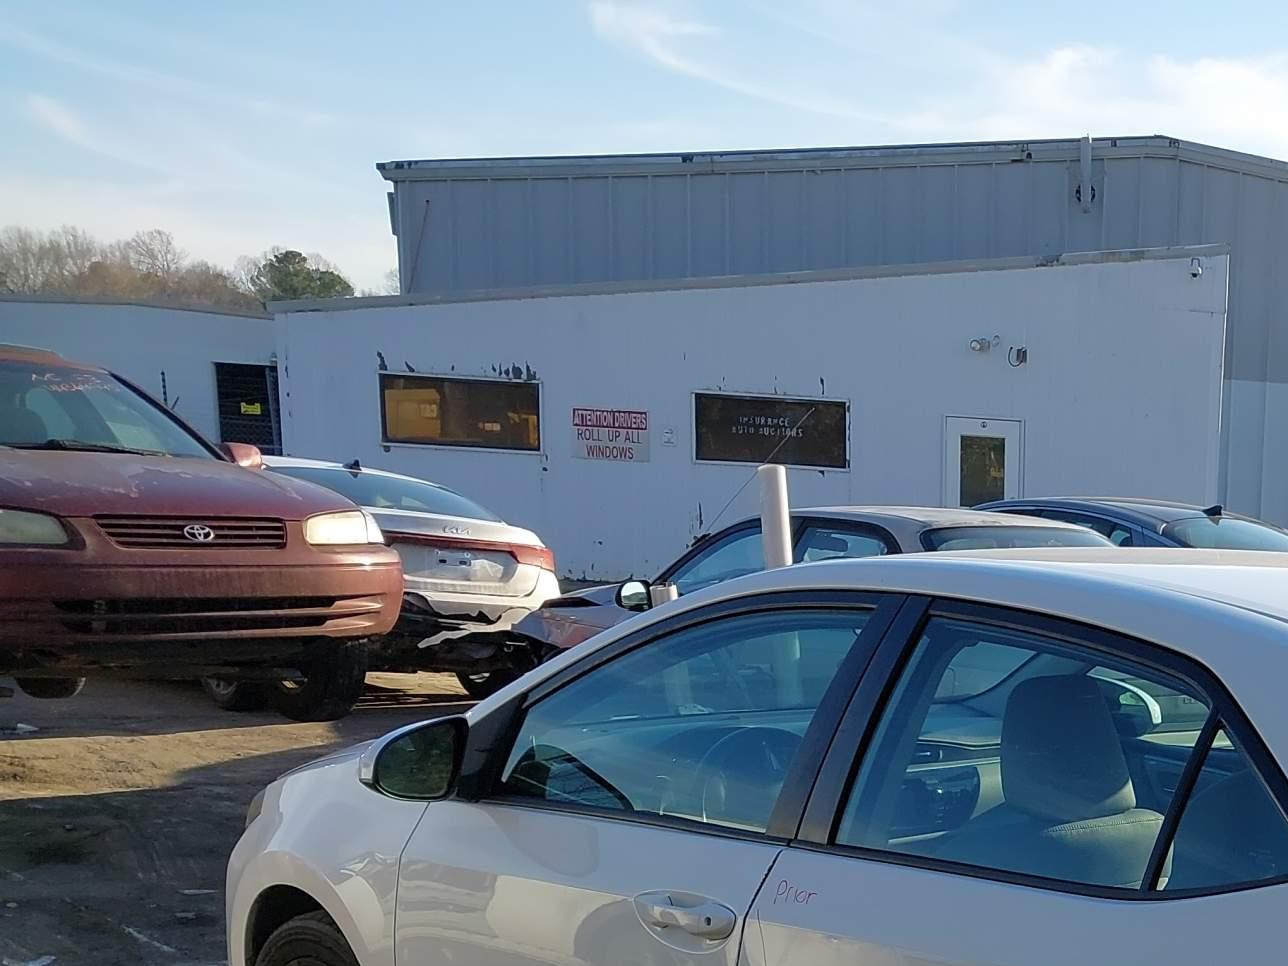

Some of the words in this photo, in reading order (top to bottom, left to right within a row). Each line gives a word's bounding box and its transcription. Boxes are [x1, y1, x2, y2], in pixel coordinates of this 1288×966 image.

[573, 409, 613, 427] ATTENTION
[614, 411, 646, 429] DRIVERS
[577, 428, 602, 442] ROLL
[608, 430, 620, 442] UP
[624, 431, 642, 444] ALL
[586, 444, 634, 460] WINDOWS
